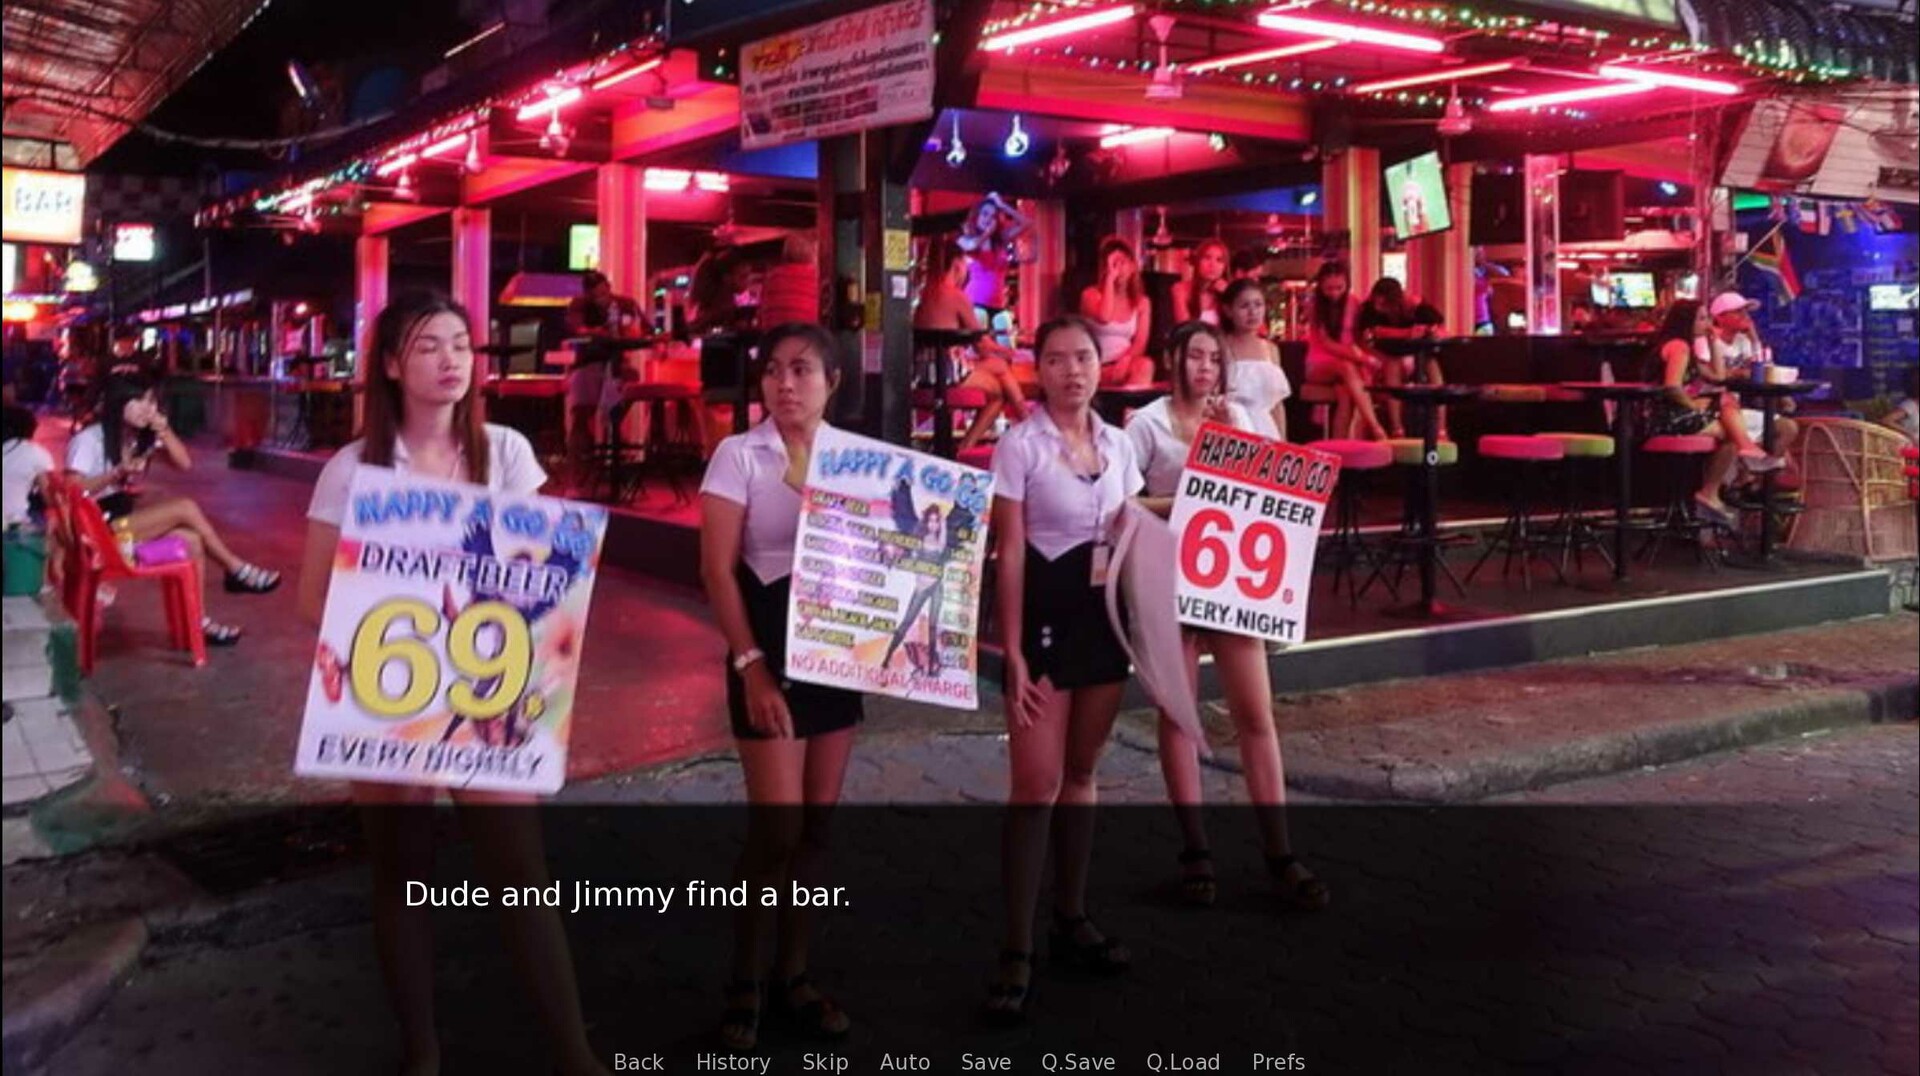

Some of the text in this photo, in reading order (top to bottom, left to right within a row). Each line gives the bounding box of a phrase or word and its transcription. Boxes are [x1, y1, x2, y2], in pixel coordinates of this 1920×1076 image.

[15, 187, 72, 213] BAR
[819, 450, 892, 478] HAPPY
[894, 458, 914, 484] A
[1197, 431, 1332, 493] HAPPY A GO GO
[354, 491, 461, 527] HAPPY
[465, 498, 493, 527] A
[1185, 476, 1316, 527] DRAFT BEER
[360, 540, 569, 603] DRAFT BEER
[1181, 508, 1287, 600] 69
[1178, 595, 1298, 640] VERY NIGHT
[349, 597, 534, 721] 69
[791, 653, 814, 673] NO
[817, 655, 909, 687] ADDITIONAL
[912, 668, 973, 701] CHARGE
[316, 734, 419, 771] EVERY
